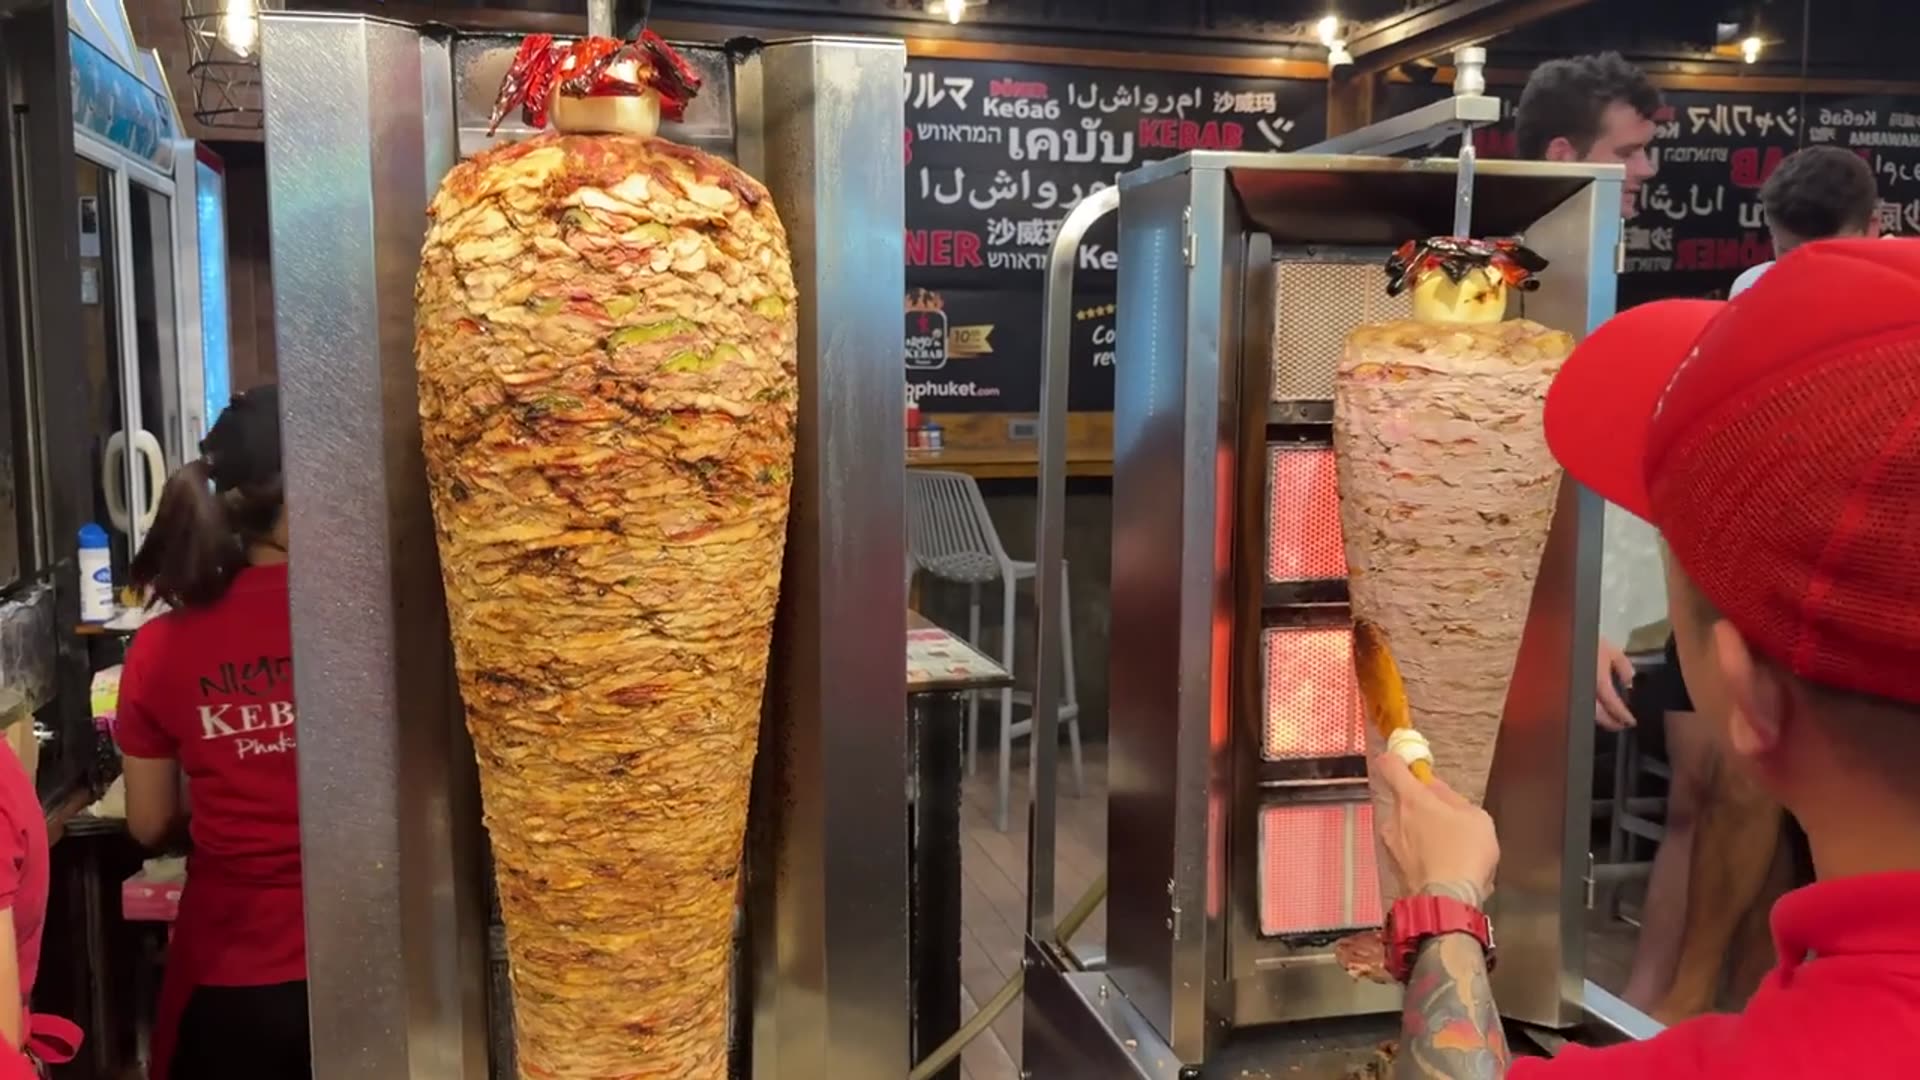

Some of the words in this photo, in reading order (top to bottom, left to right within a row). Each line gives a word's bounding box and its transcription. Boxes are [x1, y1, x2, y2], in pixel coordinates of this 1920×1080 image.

[904, 71, 974, 111] ルマ
[1008, 117, 1135, 164] เคบับ
[1138, 118, 1244, 149] KEBAB
